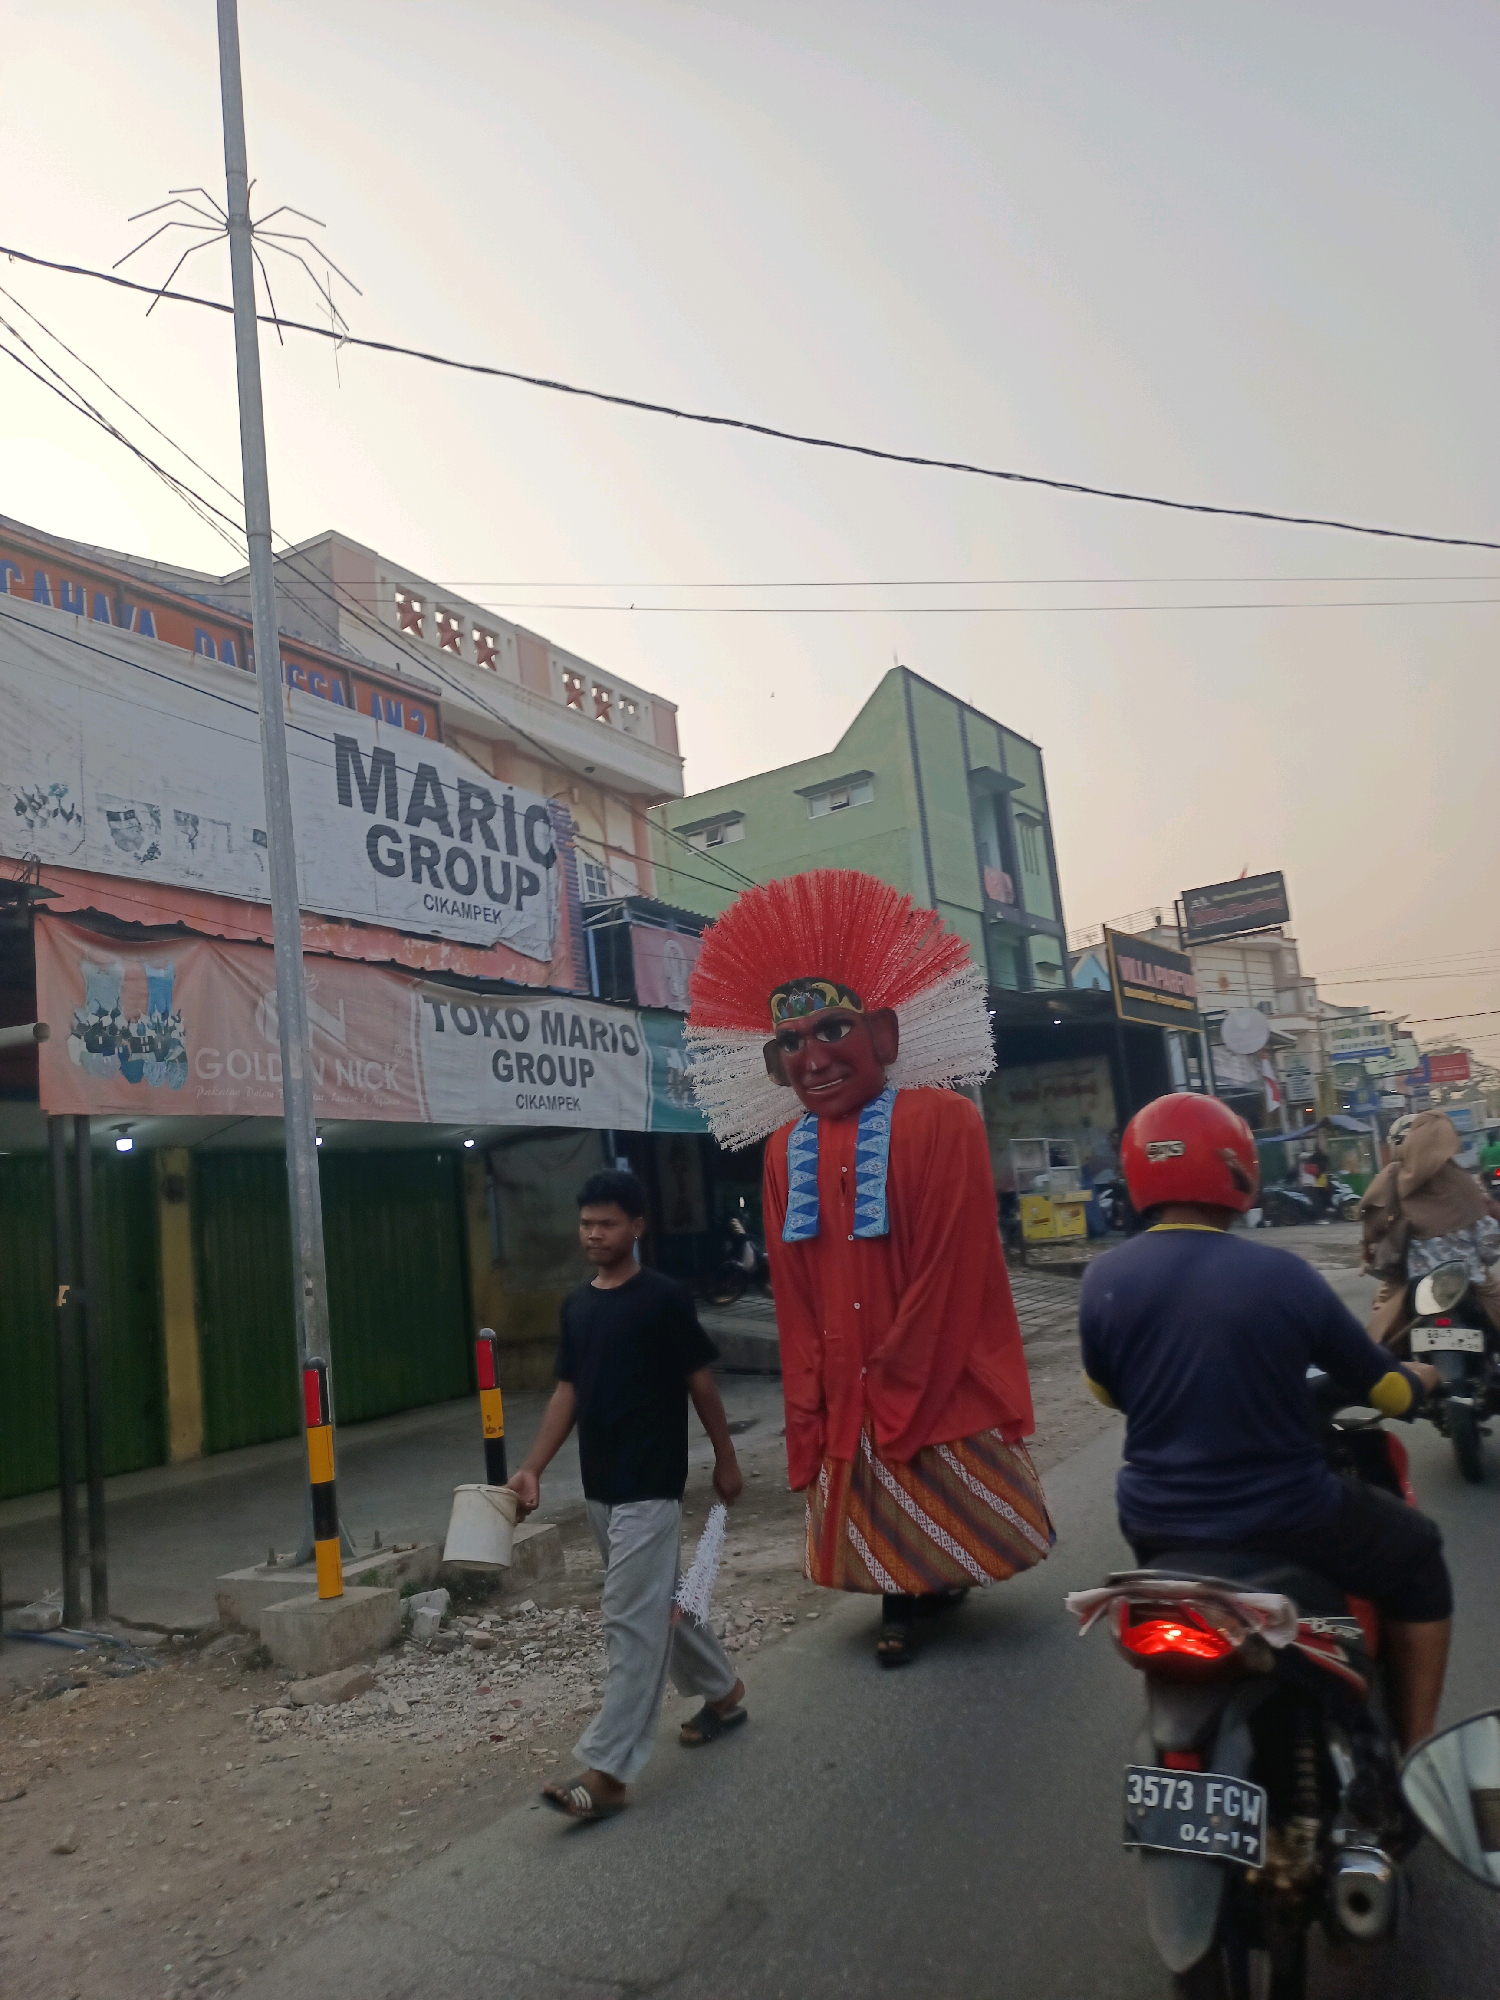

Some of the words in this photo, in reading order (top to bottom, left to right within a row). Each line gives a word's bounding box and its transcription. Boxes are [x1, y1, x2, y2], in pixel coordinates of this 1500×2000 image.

[333, 732, 557, 870] MARIO
[366, 824, 540, 911] GROUP
[423, 893, 502, 925] CIKAMPEK
[422, 995, 530, 1042] TOKO
[541, 1010, 640, 1056] MARIO
[195, 1048, 325, 1086] GOLDN
[335, 1060, 399, 1090] NICK
[492, 1049, 595, 1088] GROUP
[516, 1094, 581, 1112] CIKAMPEK
[1127, 1774, 1194, 1811] 3573
[1205, 1782, 1261, 1826] FGW
